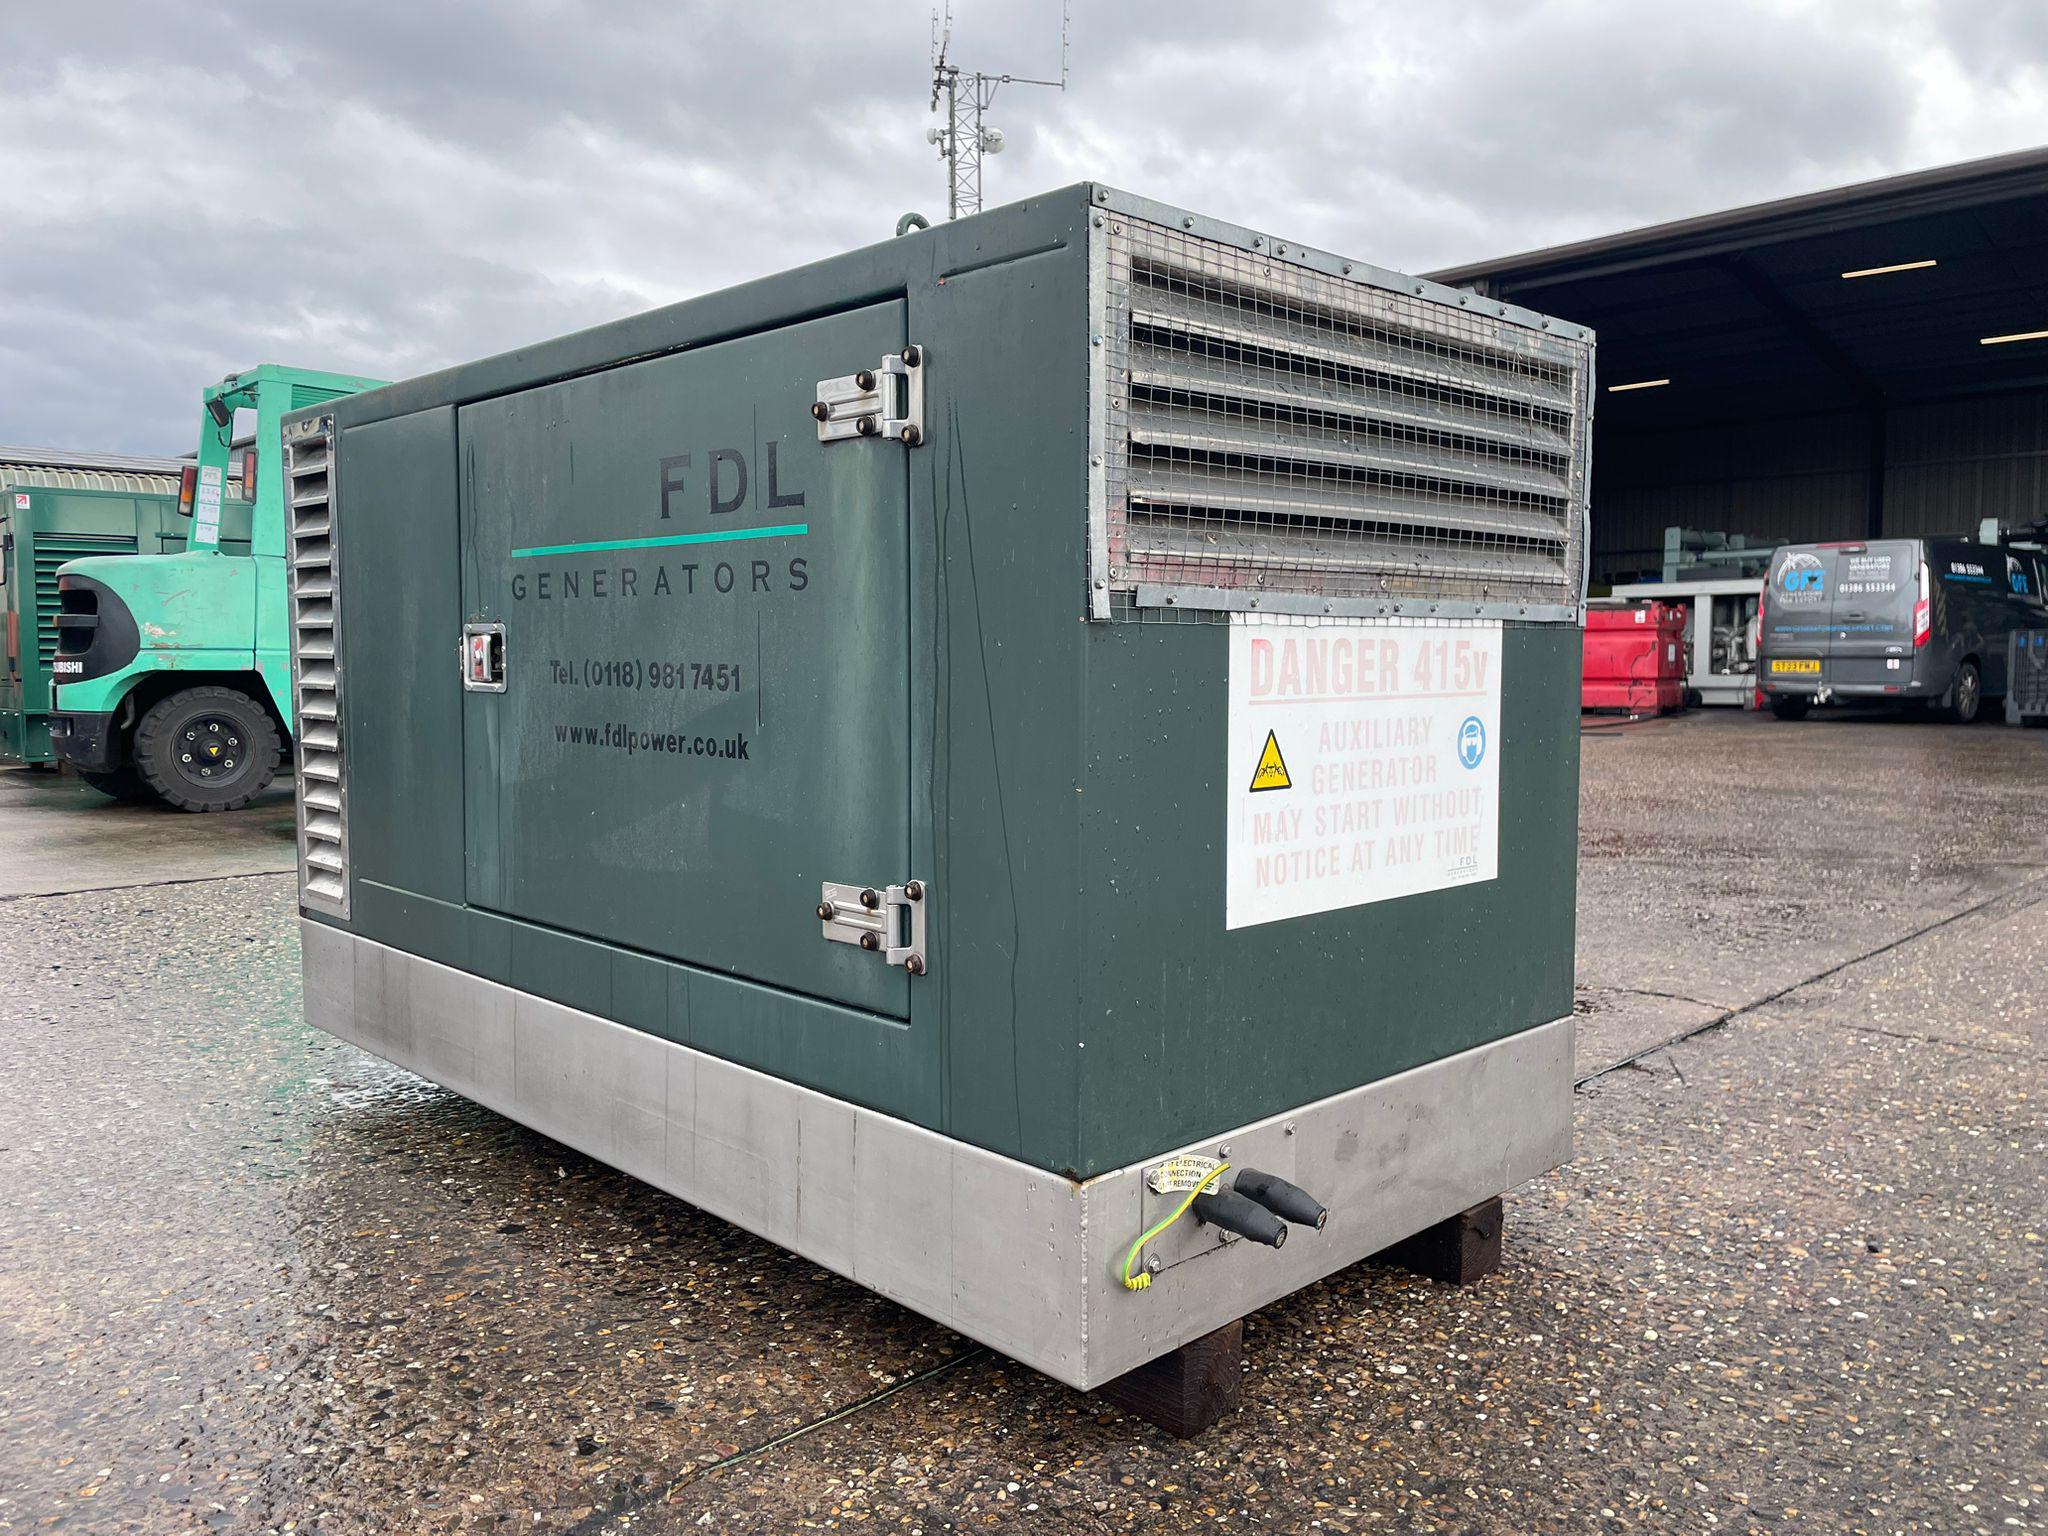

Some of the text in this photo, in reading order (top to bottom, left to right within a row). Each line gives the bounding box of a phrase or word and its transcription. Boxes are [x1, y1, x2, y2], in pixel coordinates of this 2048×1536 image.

[659, 440, 806, 520] FDL
[511, 556, 809, 601] GENERATORS
[1839, 583, 1863, 592] 01386
[550, 660, 578, 685] Tel.
[584, 658, 643, 692] (0118)
[1250, 638, 1488, 697] DANGER 415v
[555, 723, 750, 760] www.fdlpower.co.uk
[1318, 716, 1434, 753] AUXILIARY
[1311, 755, 1437, 796] GENERATOR
[1253, 787, 1482, 846] MAY START WITHOUT
[1255, 825, 1480, 889] NOTICE AT ANY TIME
[1460, 855, 1478, 866] FDL
